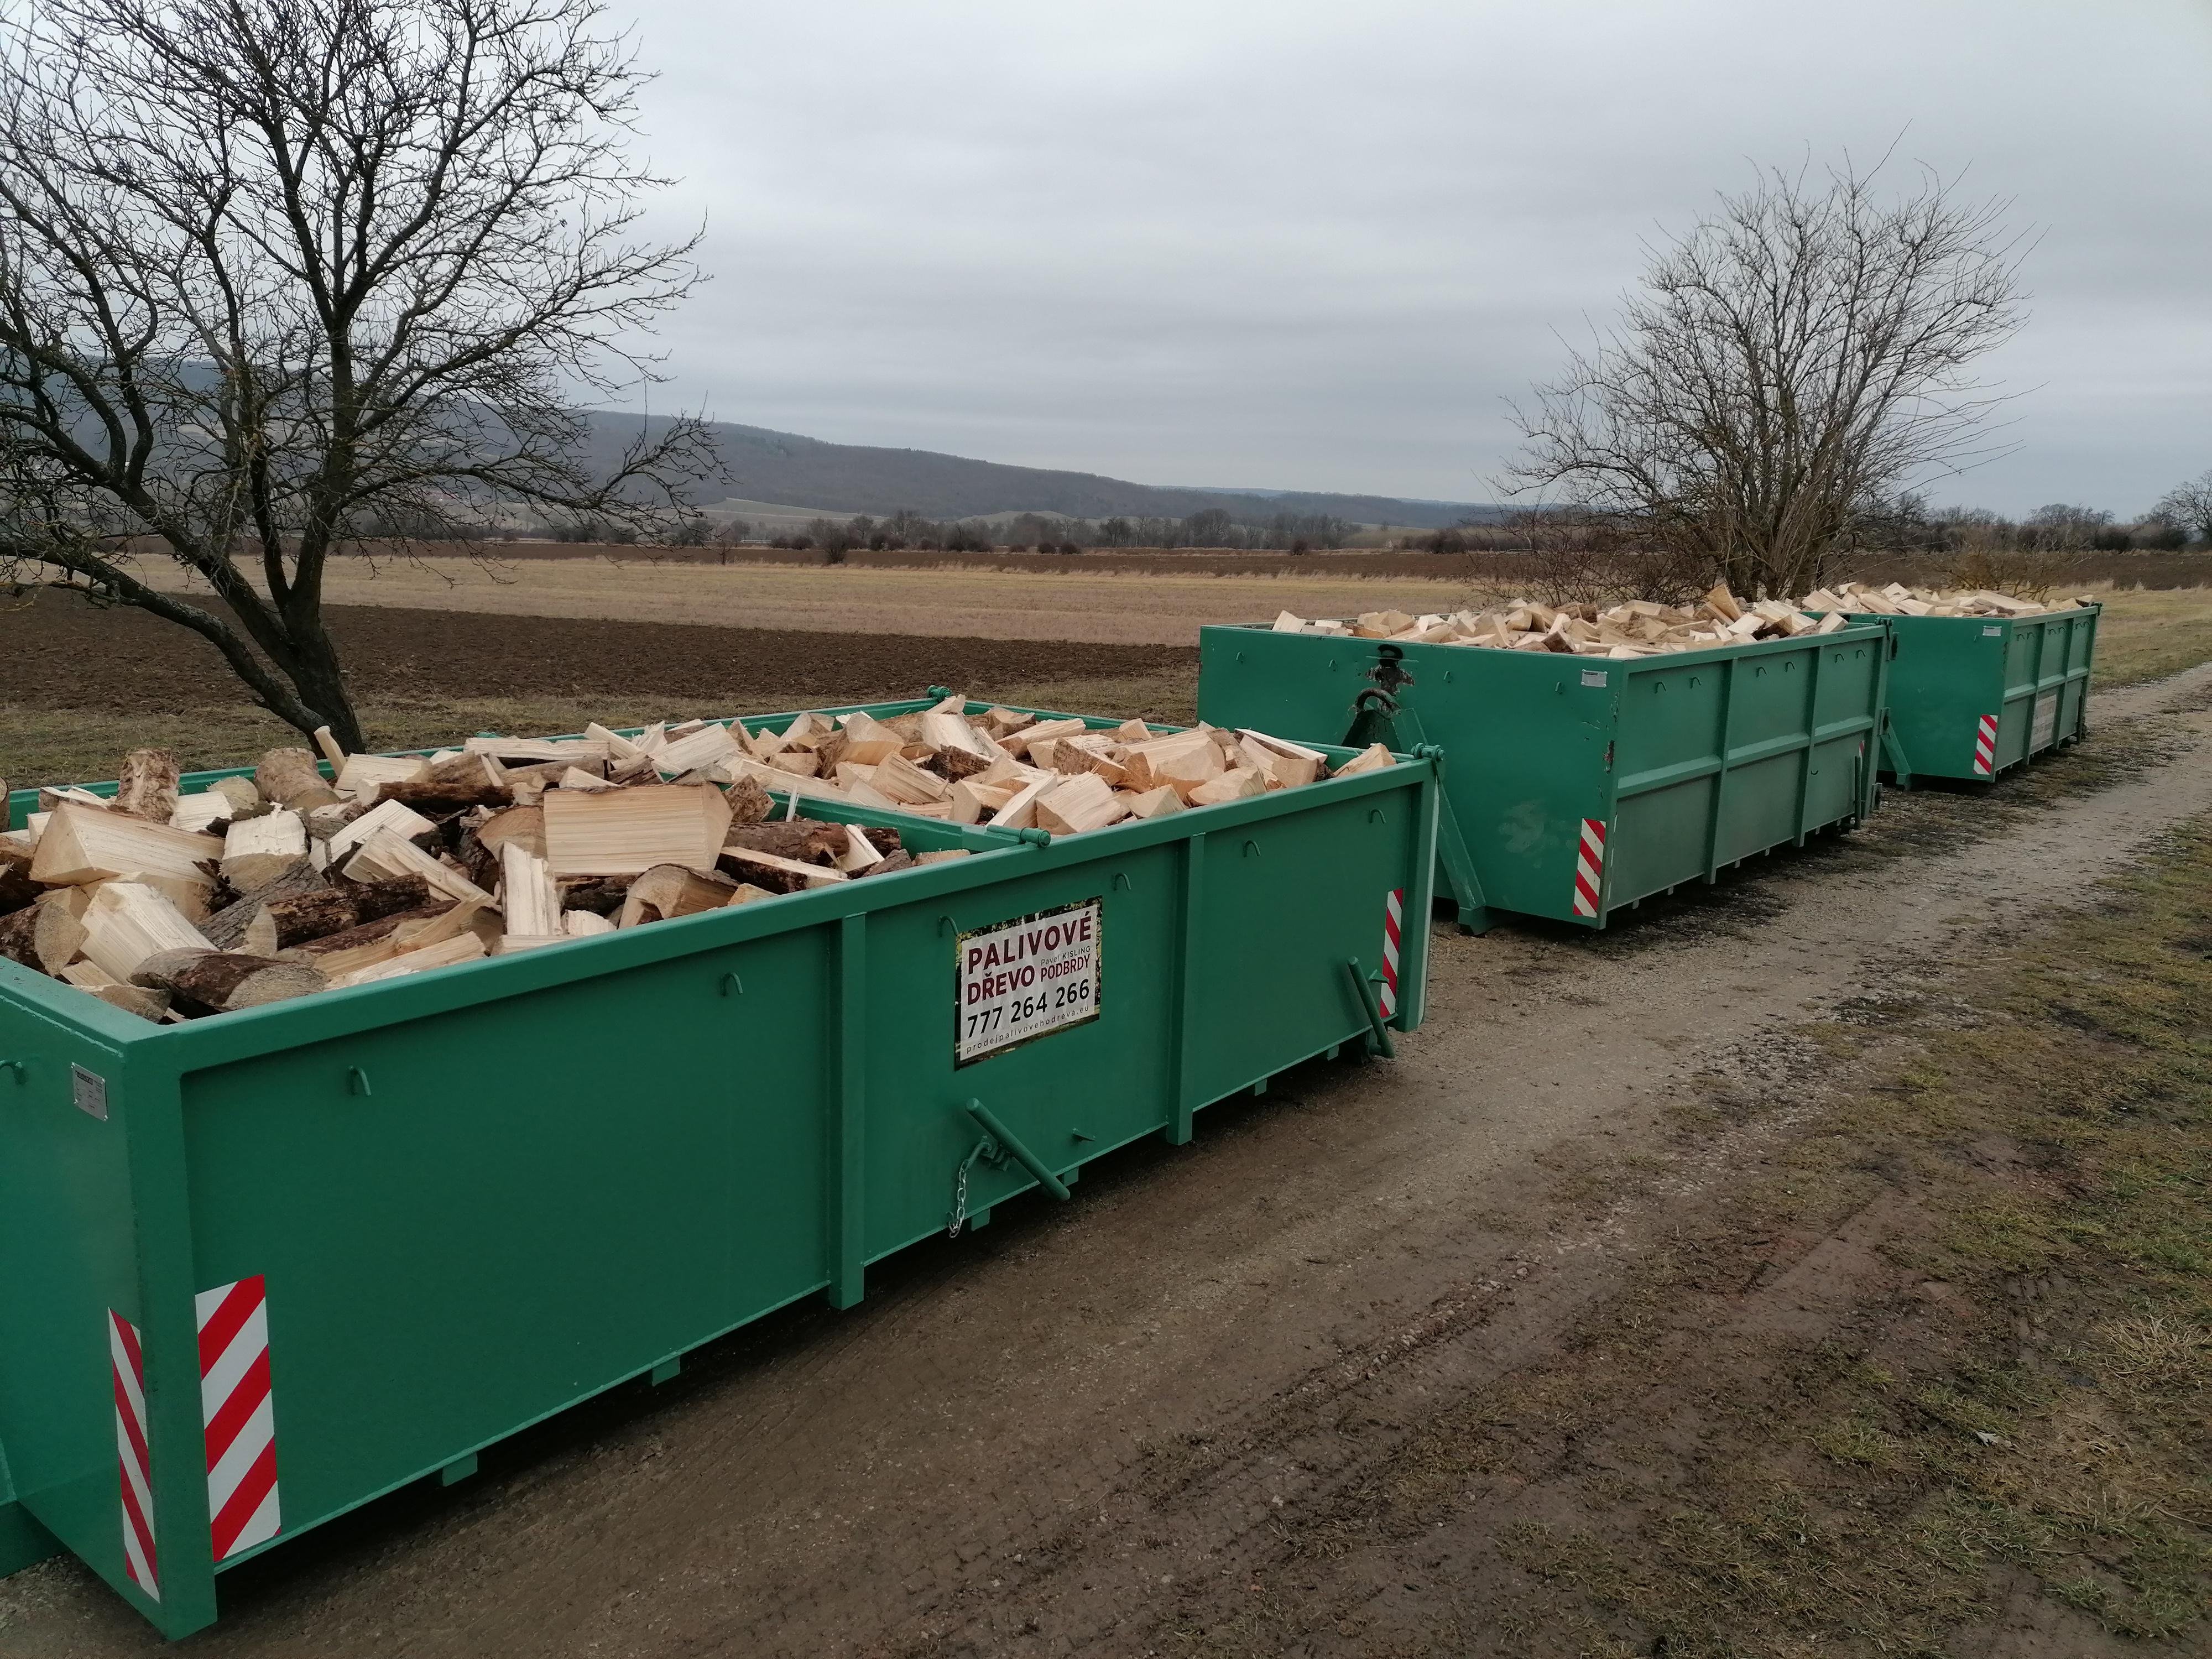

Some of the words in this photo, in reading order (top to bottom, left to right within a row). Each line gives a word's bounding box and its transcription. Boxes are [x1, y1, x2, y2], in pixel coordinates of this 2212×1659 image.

[968, 911, 1092, 975] PALIVOVÉ
[1041, 954, 1060, 966] Pavel
[1062, 946, 1091, 960] KISLING
[968, 965, 1035, 1005] DŘEVO
[1041, 953, 1090, 982] PODBRDY
[967, 1005, 1089, 1053] prodejpalivovehodreva.eu
[968, 1006, 1003, 1039] 777
[1011, 992, 1047, 1023] 264
[1055, 979, 1089, 1009] 266
